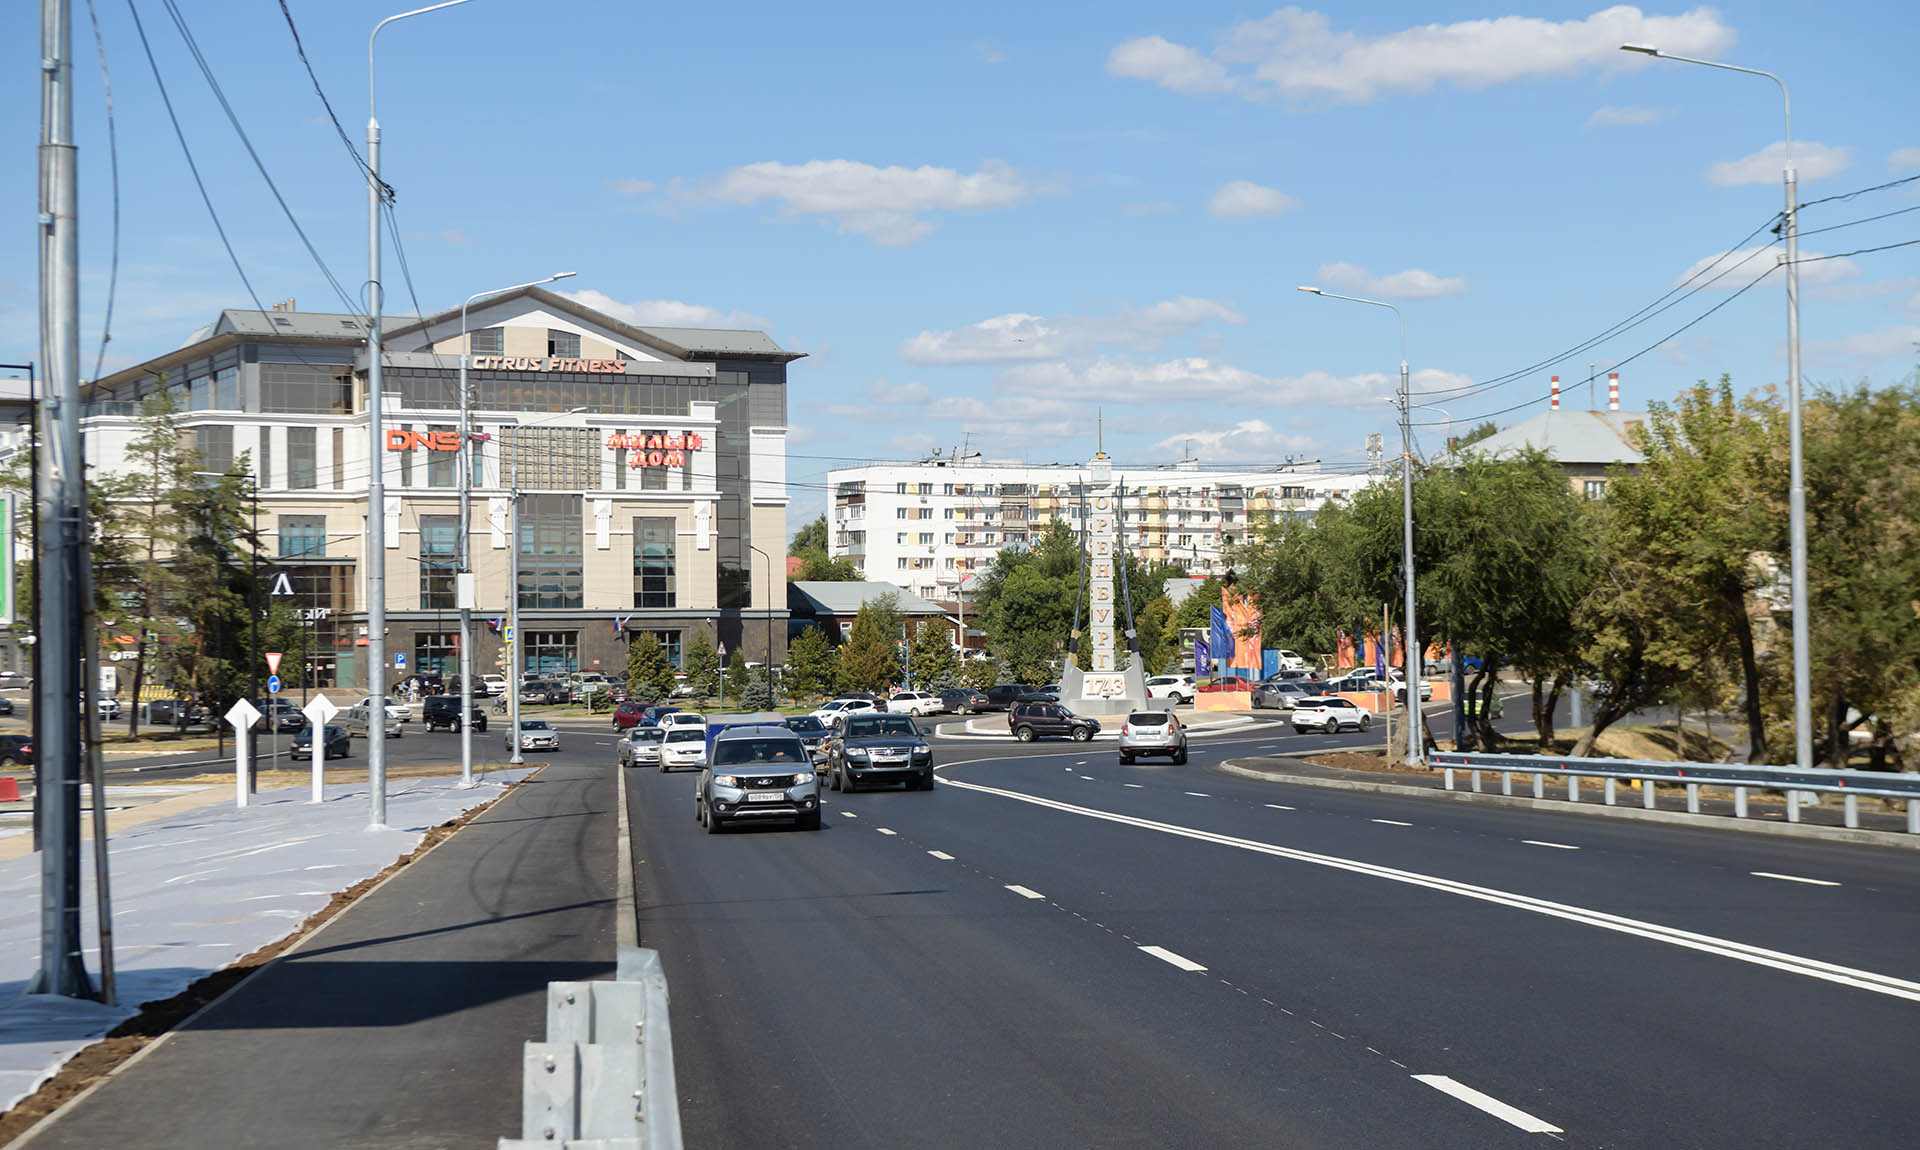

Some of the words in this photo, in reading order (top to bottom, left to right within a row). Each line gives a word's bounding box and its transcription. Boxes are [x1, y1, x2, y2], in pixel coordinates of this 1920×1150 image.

[472, 356, 542, 371] CITRUS
[387, 430, 460, 451] DNS
[629, 451, 685, 467] ДОМ
[1095, 496, 1110, 669] ОРЕНБУРГ
[1085, 678, 1125, 695] 1743
